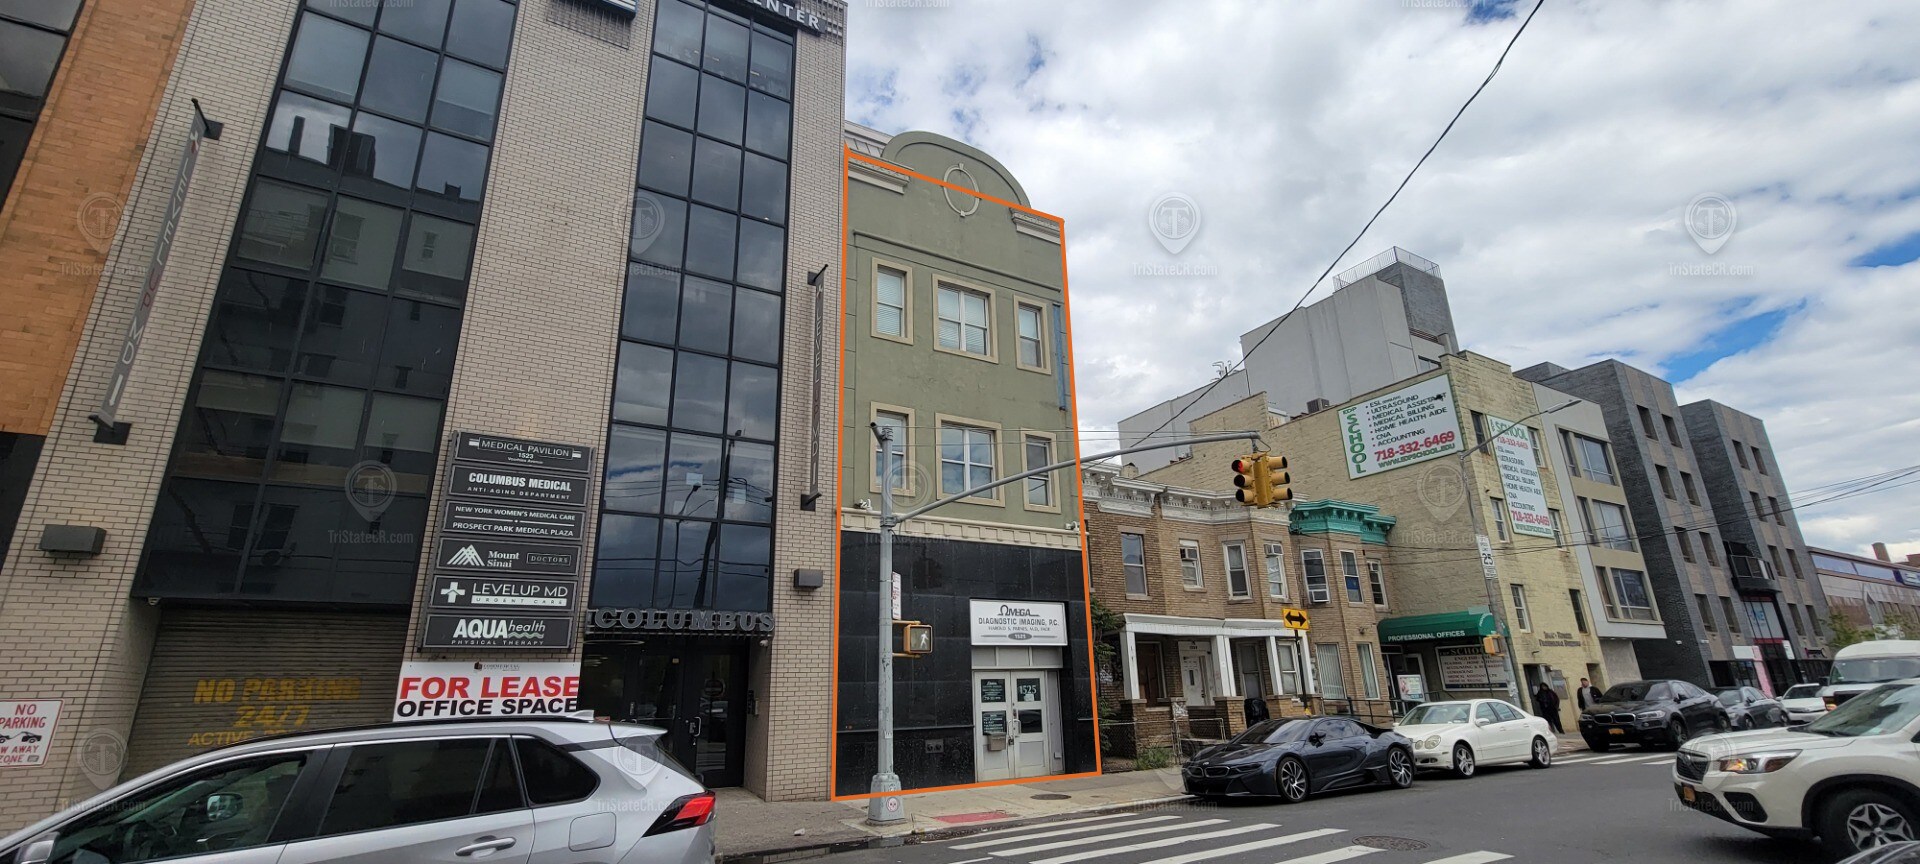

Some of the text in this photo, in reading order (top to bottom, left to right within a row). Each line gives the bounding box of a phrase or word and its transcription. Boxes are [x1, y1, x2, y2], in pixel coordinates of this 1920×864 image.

[1343, 407, 1357, 415] EDP
[1370, 394, 1419, 414] ULTRASOUND
[1372, 407, 1404, 421] MEDICAL
[1406, 392, 1447, 409] ASSISTAT
[1373, 404, 1435, 427] MEDICAL BILLING
[1375, 407, 1448, 433] HOME HEALTH AIDE
[1376, 431, 1392, 440] CNA
[1378, 428, 1426, 447] ACCOUNTING
[481, 440, 570, 457] MEDICAL PAVILION
[1346, 413, 1367, 474] SCHOOL
[1374, 431, 1455, 462] 718-332-6469
[518, 452, 534, 460] 1523
[468, 472, 572, 492] COLUMBUS MEDICAL
[519, 491, 570, 500] DEPARTMENT
[494, 508, 528, 517] WOMEN'S
[529, 512, 558, 520] MEDICAL
[559, 513, 576, 521] CARE
[452, 522, 574, 537] PROSPECT PARK MEDICAL PLAZA
[487, 560, 512, 568] Sinai
[488, 551, 569, 564] Mount DOCTORS
[1482, 553, 1494, 565] 25
[472, 583, 569, 597] LEVELUP MD
[594, 607, 775, 632] COLUMBUS
[978, 617, 1017, 626] DIAGNOSTIC
[1387, 630, 1466, 642] PROFESSIONAL OFFICES
[193, 676, 363, 704] NO PARKING
[400, 676, 580, 699] FOR LEASE
[1018, 684, 1037, 694] 1525
[15, 704, 37, 715] NO
[397, 698, 577, 717] OFFICE SPACE
[232, 705, 311, 729] 24/7
[11, 745, 39, 753] AWAY
